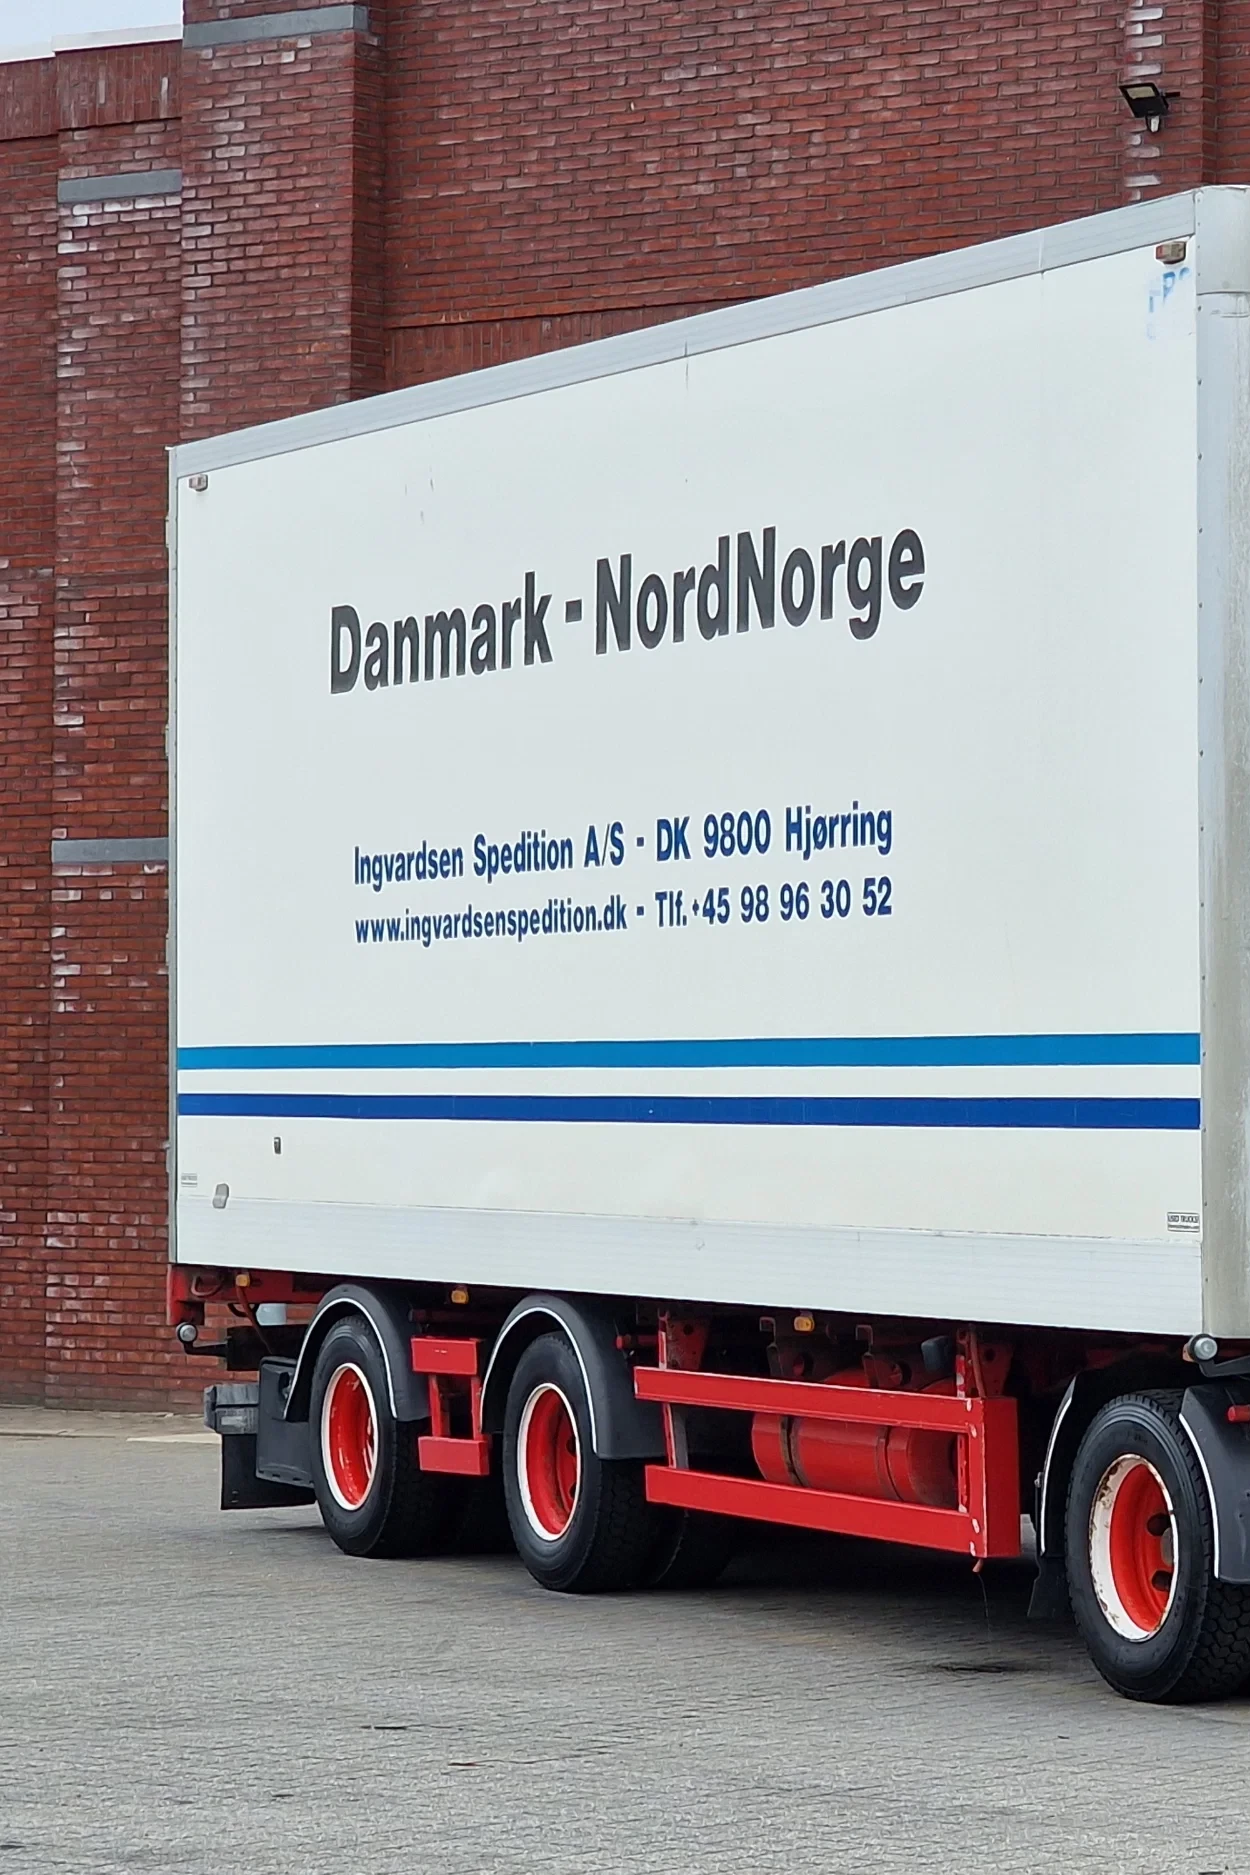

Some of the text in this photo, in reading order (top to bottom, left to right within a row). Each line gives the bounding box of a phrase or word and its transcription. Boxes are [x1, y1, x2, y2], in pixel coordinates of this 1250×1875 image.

[330, 571, 553, 695] Danmark
[595, 525, 926, 655] NordNorge
[354, 840, 464, 893] Ingvardsen
[473, 829, 573, 884] Spedition
[583, 821, 625, 868] A/S
[656, 816, 691, 862] DK
[703, 808, 772, 859] 9800
[785, 800, 892, 861] Hjørring
[355, 894, 628, 948] www.ingvardsenspedition.dk
[740, 884, 770, 923] 98
[779, 881, 810, 922] 96
[820, 879, 851, 919] 30
[862, 875, 892, 917] 52
